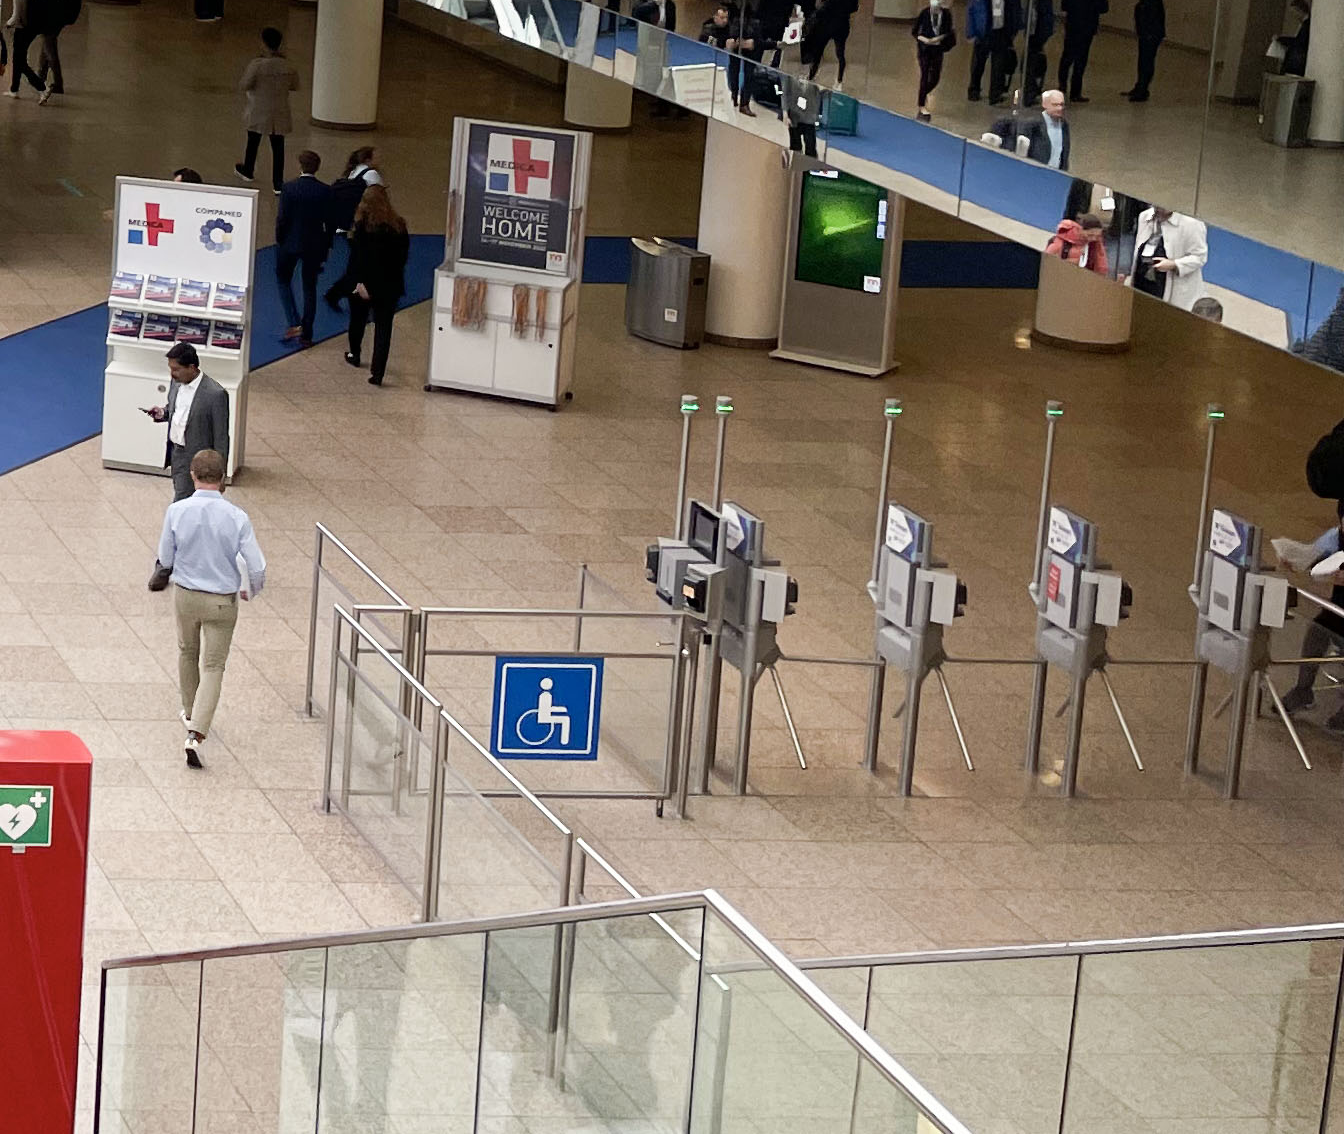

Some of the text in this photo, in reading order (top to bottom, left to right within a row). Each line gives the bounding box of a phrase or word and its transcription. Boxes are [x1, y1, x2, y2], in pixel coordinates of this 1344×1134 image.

[489, 159, 536, 173] MEDICA
[195, 207, 243, 218] COMPAMED
[483, 205, 549, 225] WELCOME
[128, 218, 164, 229] MEDICA
[481, 216, 549, 243] HOME
